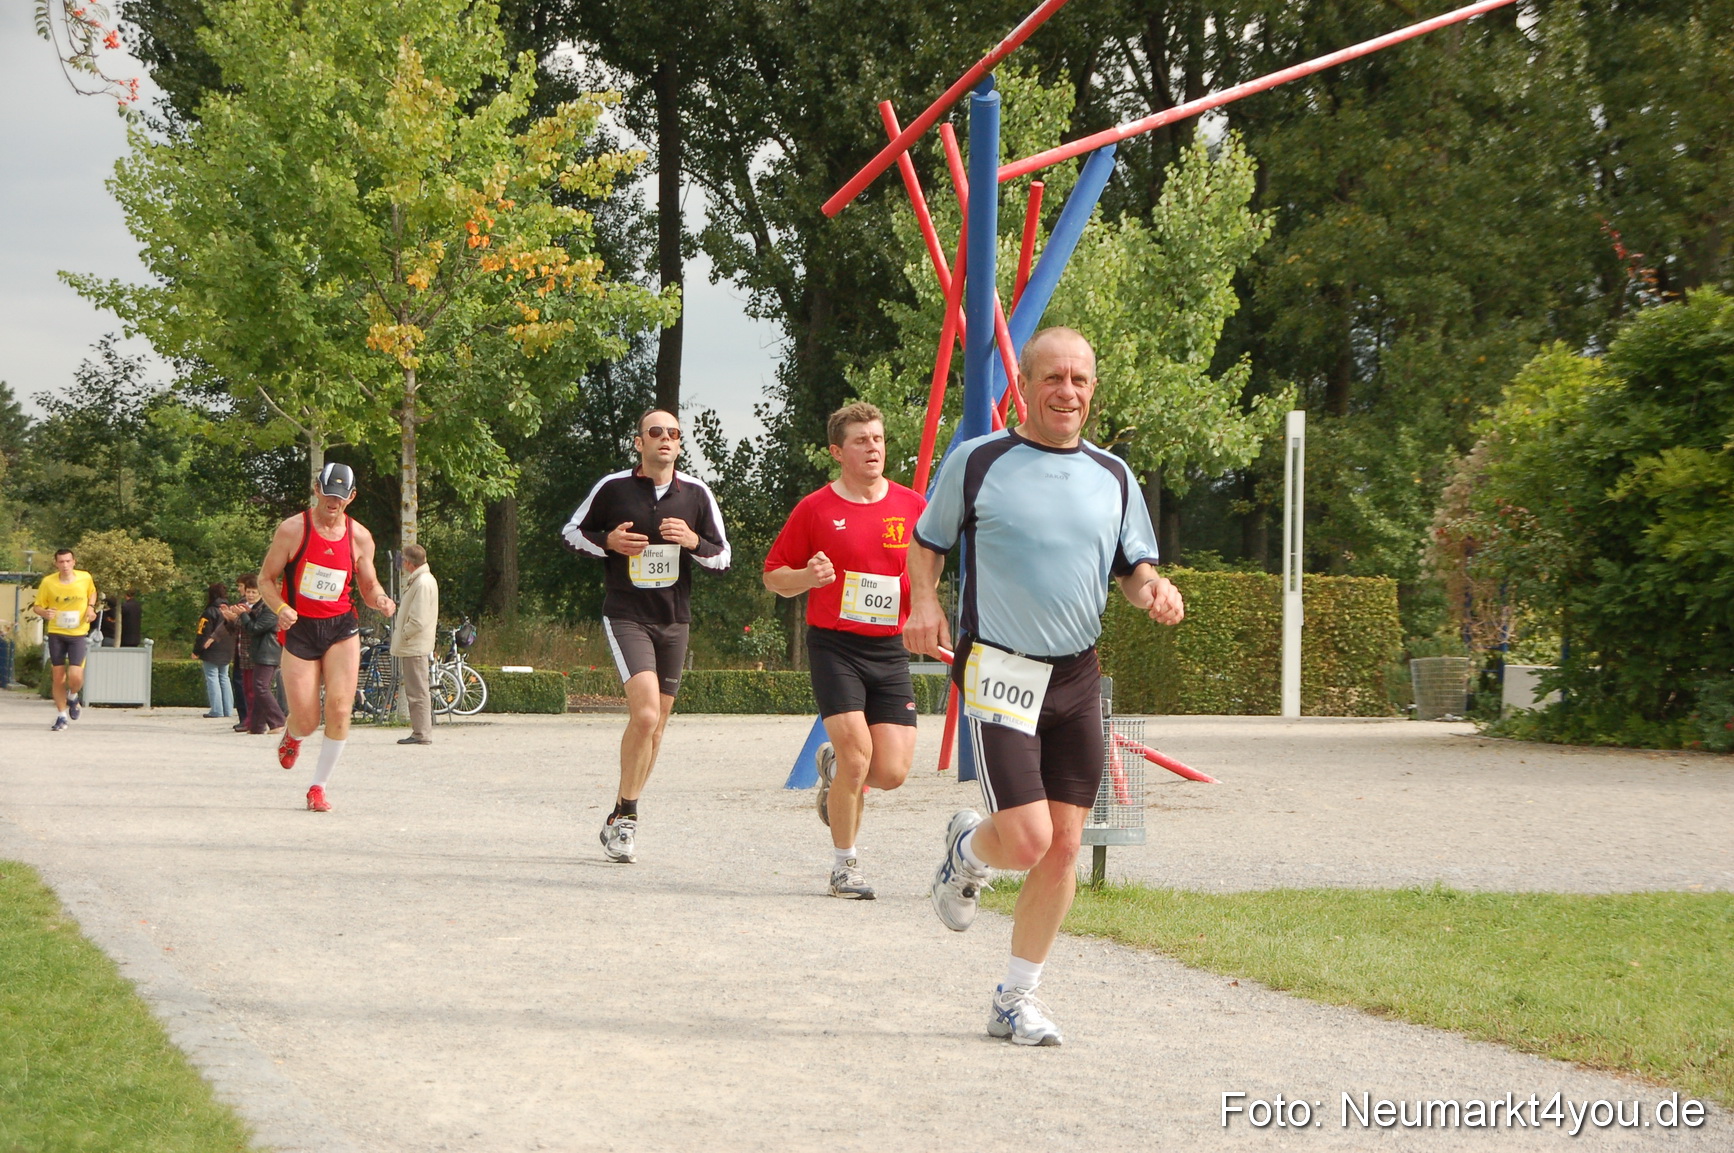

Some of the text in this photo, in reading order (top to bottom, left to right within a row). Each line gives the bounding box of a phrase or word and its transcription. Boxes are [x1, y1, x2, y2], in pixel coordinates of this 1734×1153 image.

[643, 549, 664, 558] Alfred
[648, 561, 670, 575] 381
[316, 580, 337, 592] 870
[861, 577, 878, 589] Otto
[864, 593, 893, 609] 602
[981, 677, 1034, 710] 1000
